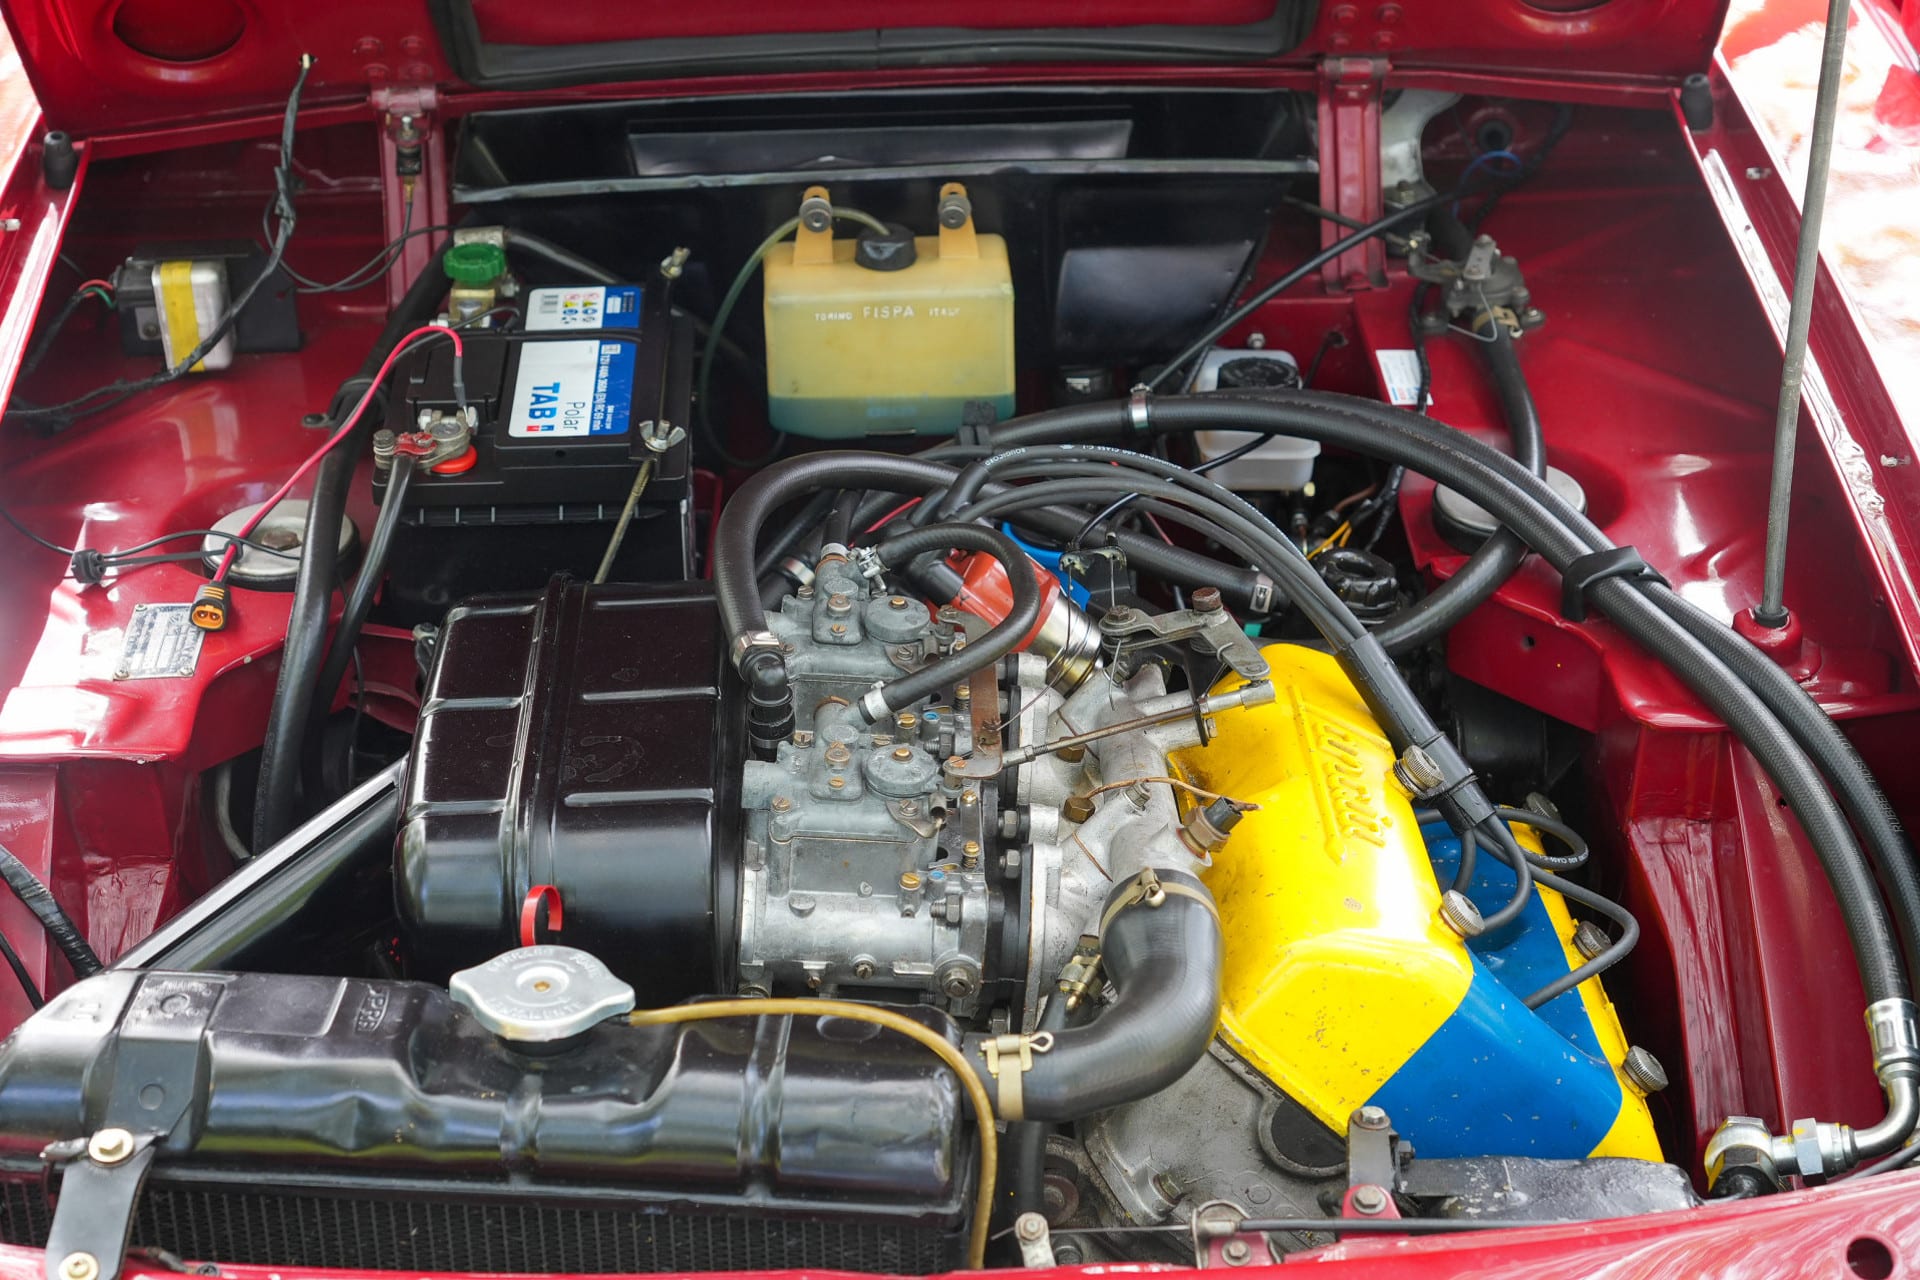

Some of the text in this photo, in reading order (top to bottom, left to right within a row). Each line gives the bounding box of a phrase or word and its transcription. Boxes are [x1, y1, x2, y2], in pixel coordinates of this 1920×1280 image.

[862, 304, 915, 320] FISPA
[528, 382, 561, 419] TAB
[563, 401, 586, 431] Polar
[1872, 789, 1904, 832] RUBBER
